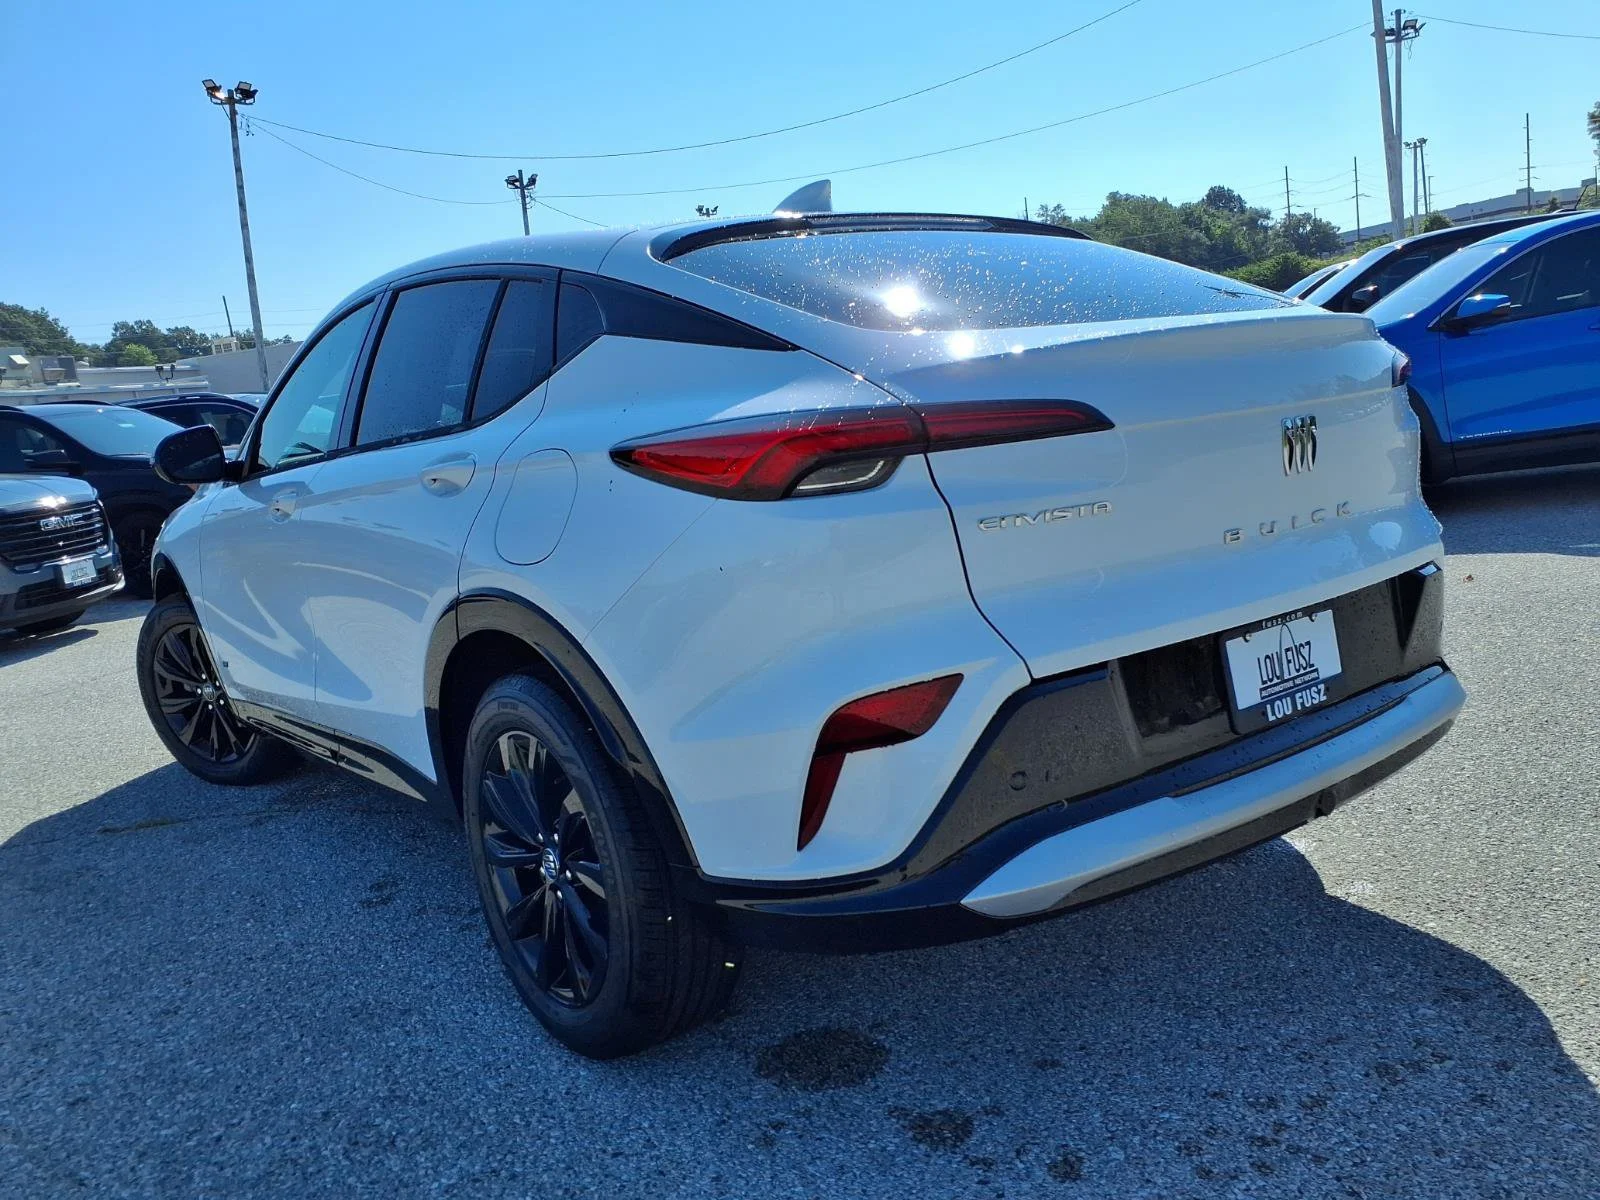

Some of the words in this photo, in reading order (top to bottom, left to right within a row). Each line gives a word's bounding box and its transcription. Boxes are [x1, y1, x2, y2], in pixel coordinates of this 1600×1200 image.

[40, 513, 83, 531] GMC
[977, 501, 1113, 532] ENVISTA
[1224, 501, 1352, 545] BUICK
[1262, 612, 1303, 629] fusz.com
[1257, 651, 1281, 685] LOU
[1284, 640, 1315, 677] FUSZ
[1266, 697, 1293, 722] LOU
[1295, 684, 1327, 711] FUSZ
